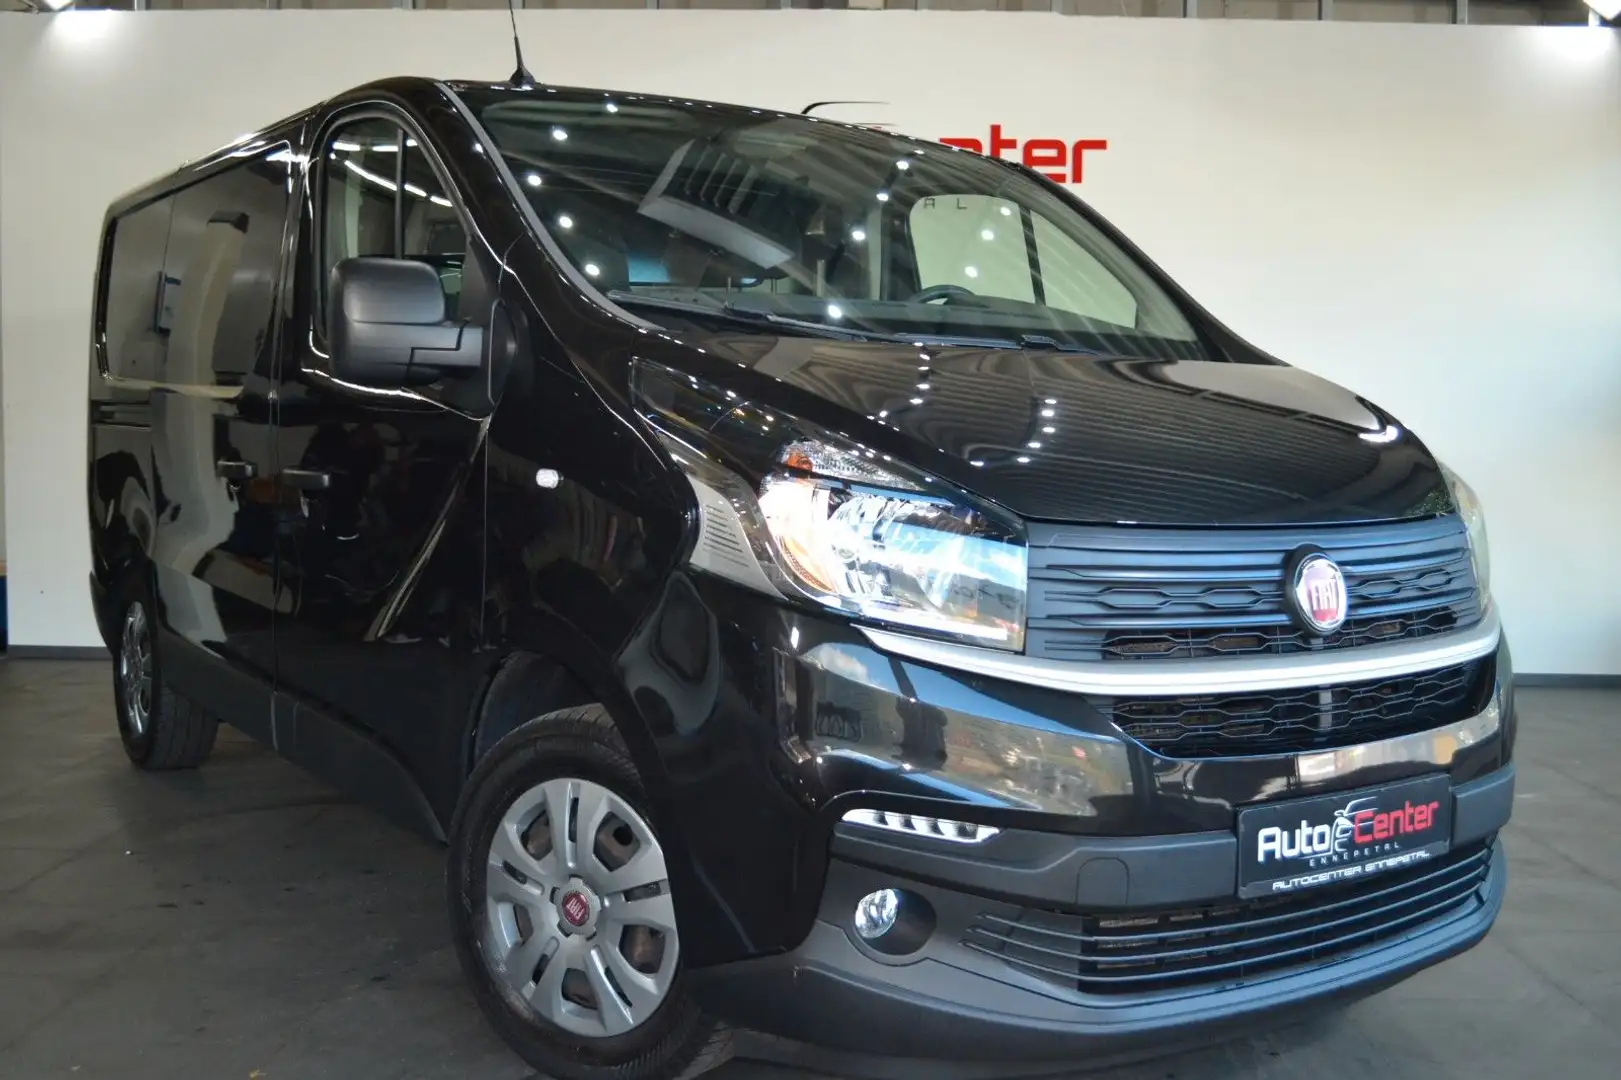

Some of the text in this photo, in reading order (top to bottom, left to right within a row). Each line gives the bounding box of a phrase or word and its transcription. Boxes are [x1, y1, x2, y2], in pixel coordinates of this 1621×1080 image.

[1257, 800, 1440, 863] Auto Center
[1308, 842, 1400, 868] ENNEPETAL
[1272, 865, 1362, 891] AUTOCENTER
